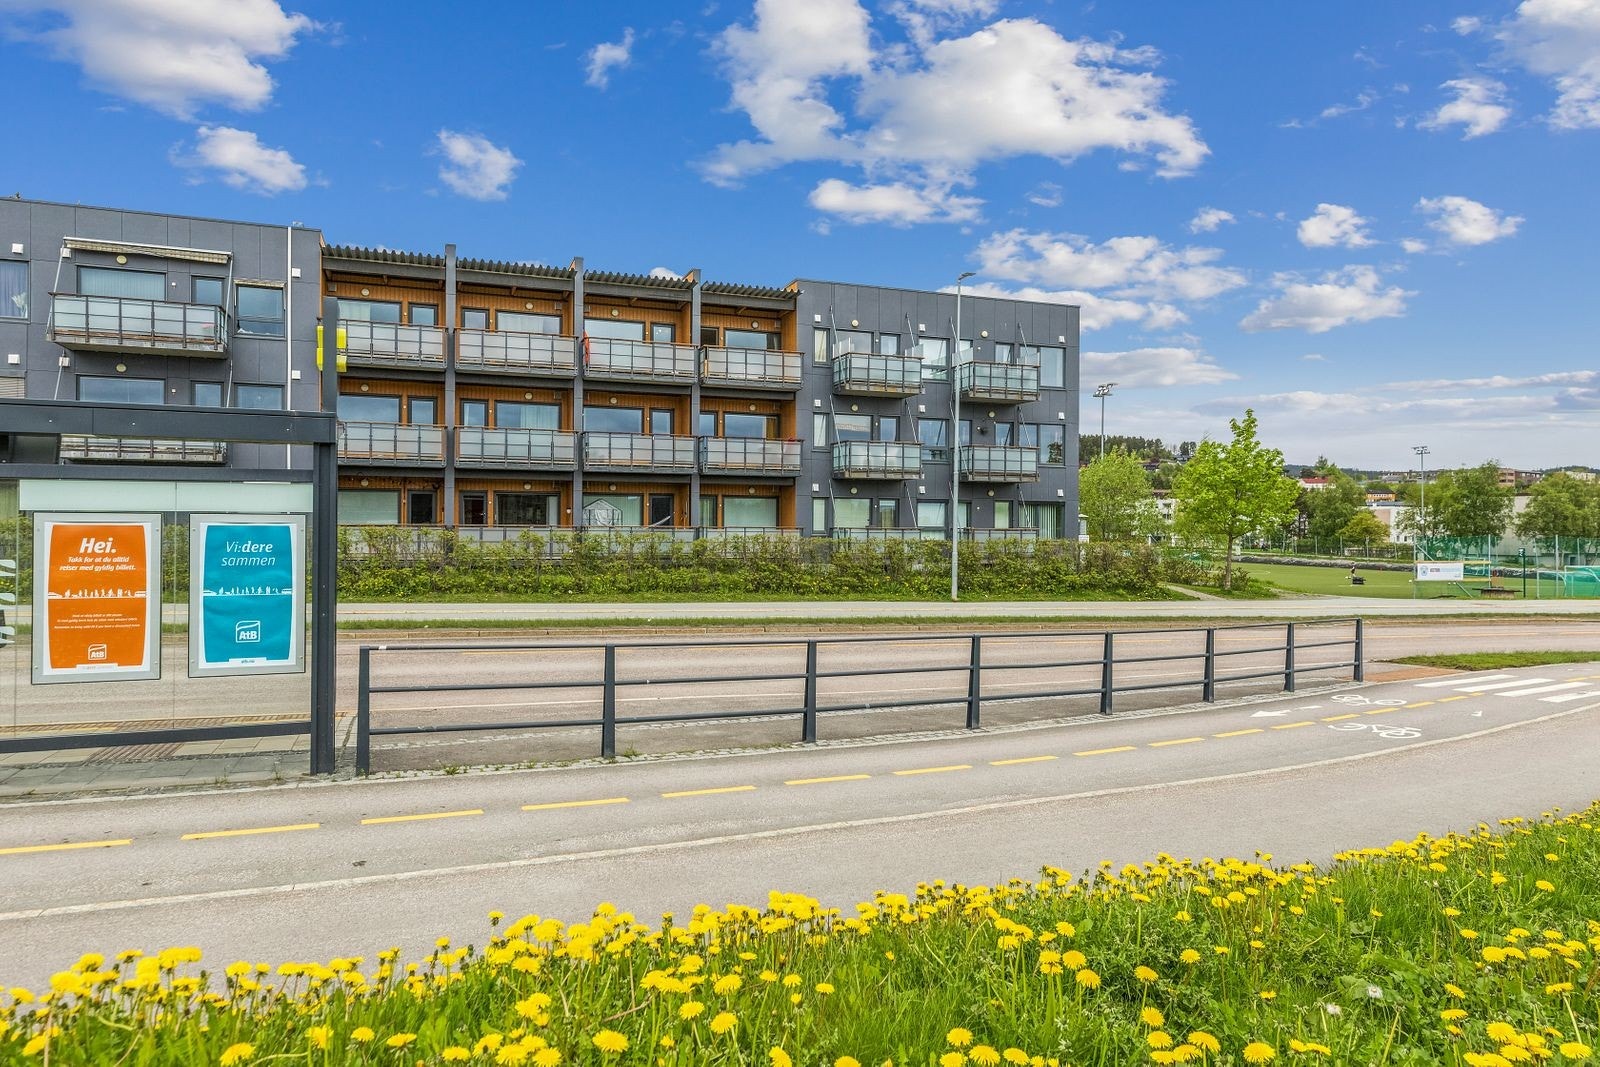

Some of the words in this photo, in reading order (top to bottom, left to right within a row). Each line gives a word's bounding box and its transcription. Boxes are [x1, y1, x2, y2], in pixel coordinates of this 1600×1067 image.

[79, 537, 116, 553] Hei.
[226, 540, 273, 553] Vi:dere
[84, 556, 93, 564] for
[221, 556, 276, 567] sammen
[94, 564, 114, 572] gyldig
[239, 630, 257, 640] AtB
